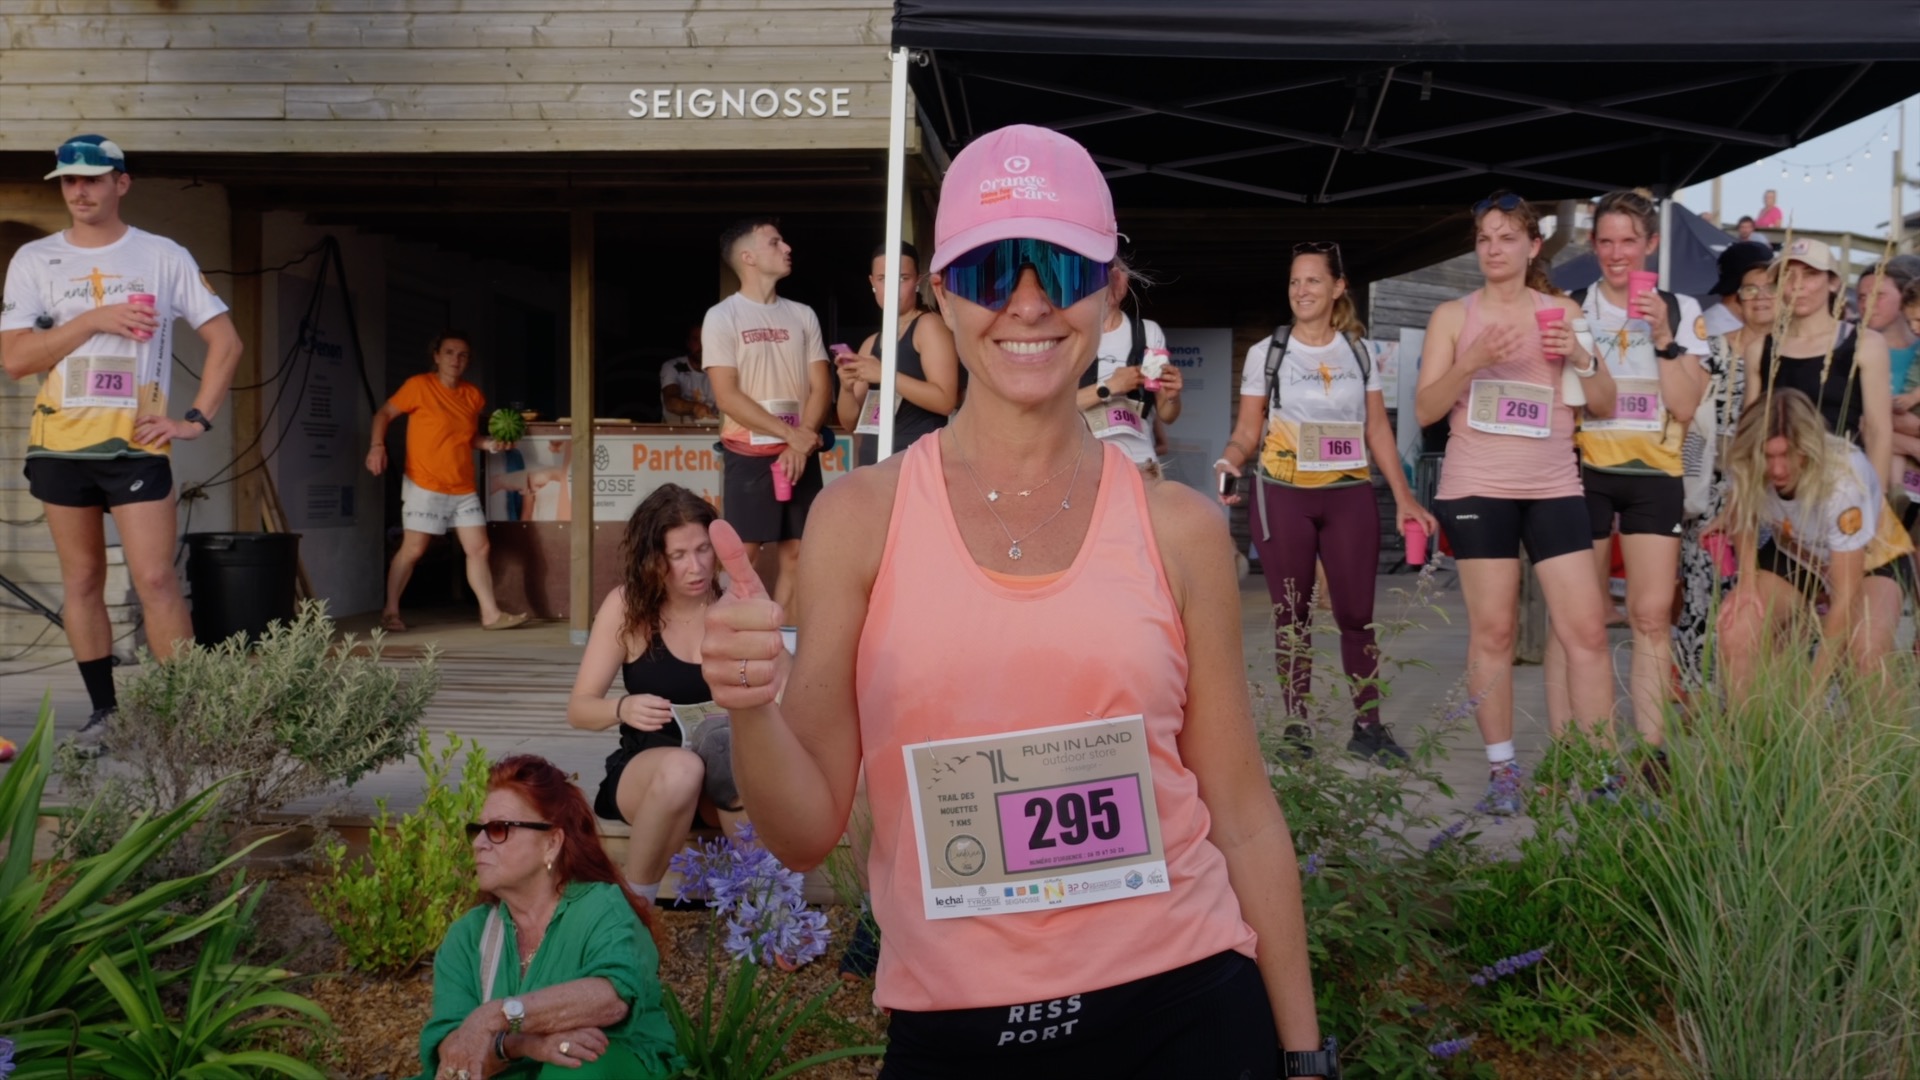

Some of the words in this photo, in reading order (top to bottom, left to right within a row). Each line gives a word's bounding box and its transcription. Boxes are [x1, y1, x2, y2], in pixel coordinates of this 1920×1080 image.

[628, 87, 851, 119] SEIGNOSSE
[980, 176, 1047, 192] Orange
[1012, 187, 1059, 202] Care
[95, 373, 123, 390] 273
[1505, 401, 1539, 420] 269
[1327, 440, 1352, 456] 166
[821, 449, 844, 472] et
[1022, 741, 1060, 757] RUN
[1063, 738, 1080, 751] IN
[1085, 731, 1132, 748] LAND
[1042, 752, 1086, 767] outdoor
[1090, 747, 1117, 760] store
[937, 794, 959, 803] TRAIL
[961, 792, 975, 800] DES
[940, 804, 978, 815] MOUETTES
[956, 818, 972, 827] KMS
[1024, 787, 1120, 850] 295
[935, 896, 944, 906] le
[945, 894, 964, 905] chai
[1005, 896, 1040, 905] SEIGNOSSE
[1008, 994, 1082, 1023] RESS
[997, 1019, 1078, 1046] PORT
